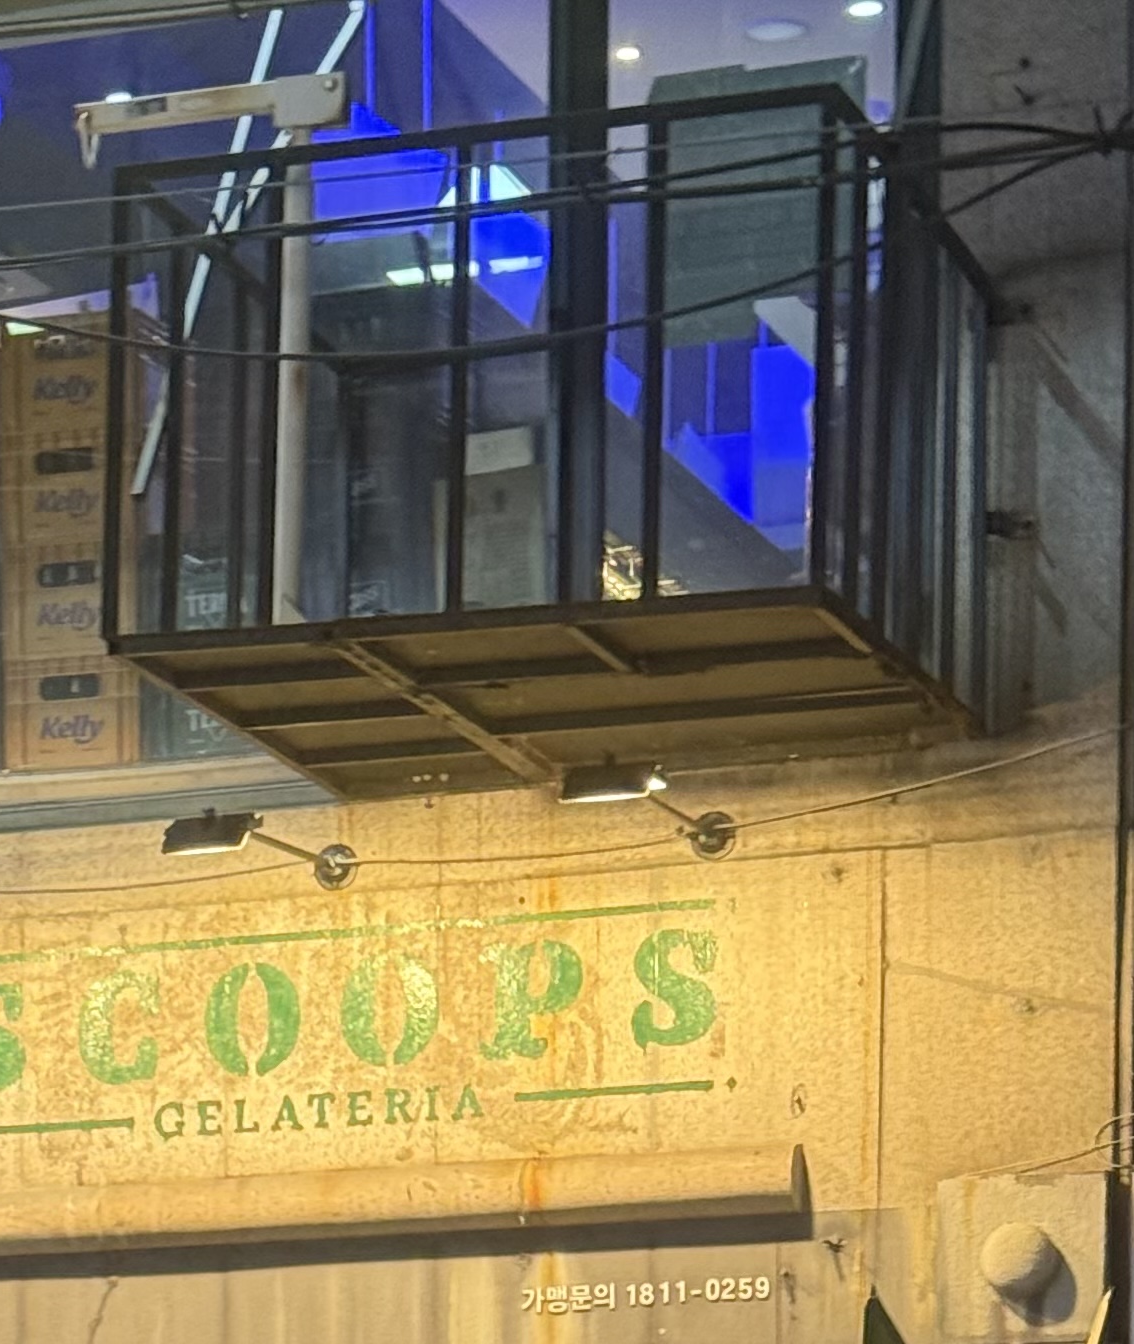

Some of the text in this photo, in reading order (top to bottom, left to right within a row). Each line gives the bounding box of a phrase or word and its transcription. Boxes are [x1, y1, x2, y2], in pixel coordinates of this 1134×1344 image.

[39, 714, 106, 745] Kelly
[153, 1083, 485, 1141] GELATERIA
[520, 1275, 771, 1315] 가맹문의 1811-0259
